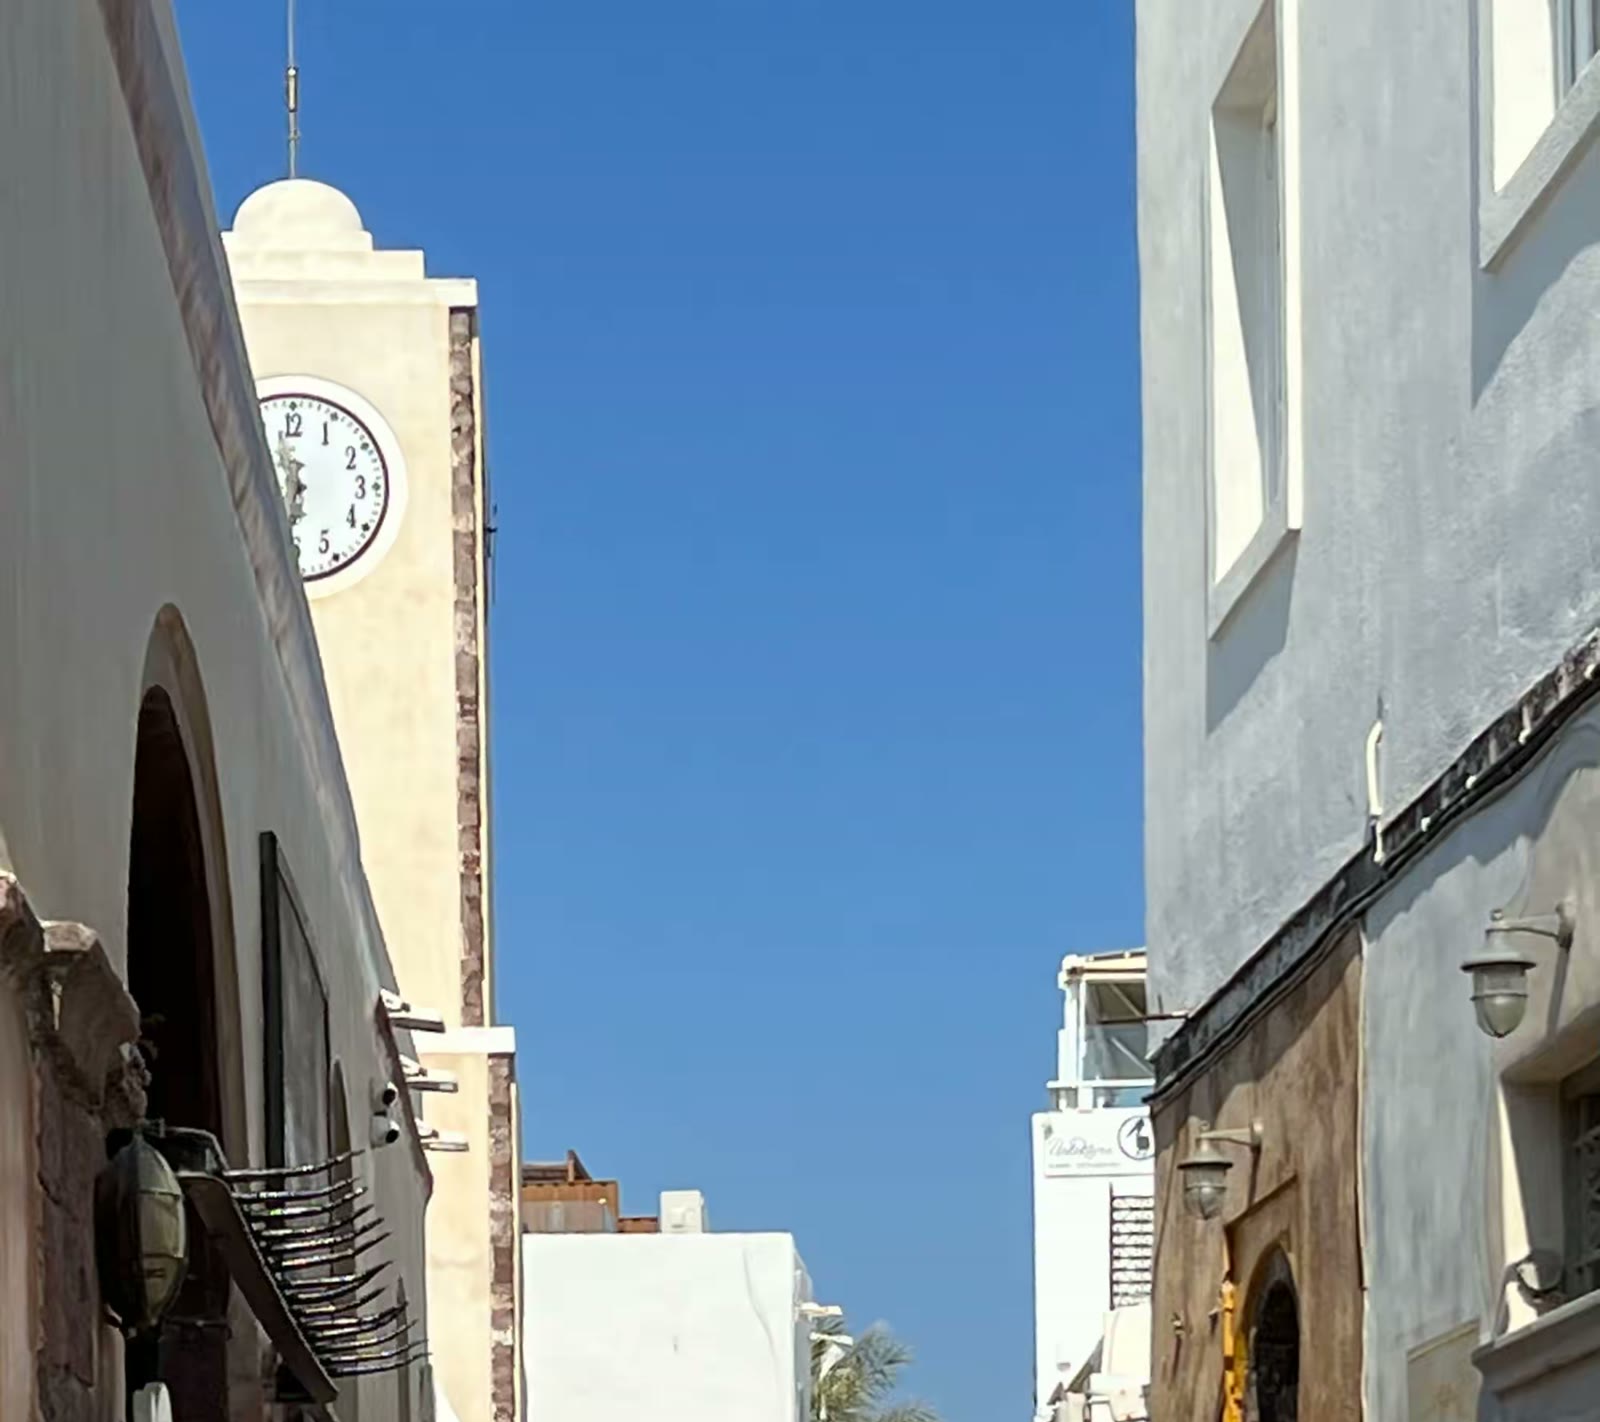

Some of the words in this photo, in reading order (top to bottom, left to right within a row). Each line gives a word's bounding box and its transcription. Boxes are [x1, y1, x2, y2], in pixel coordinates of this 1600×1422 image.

[285, 413, 302, 437] 12
[322, 422, 329, 446] 1
[345, 446, 356, 470] 2
[355, 475, 365, 499] 3
[346, 504, 356, 528] 4
[319, 529, 329, 554] 5
